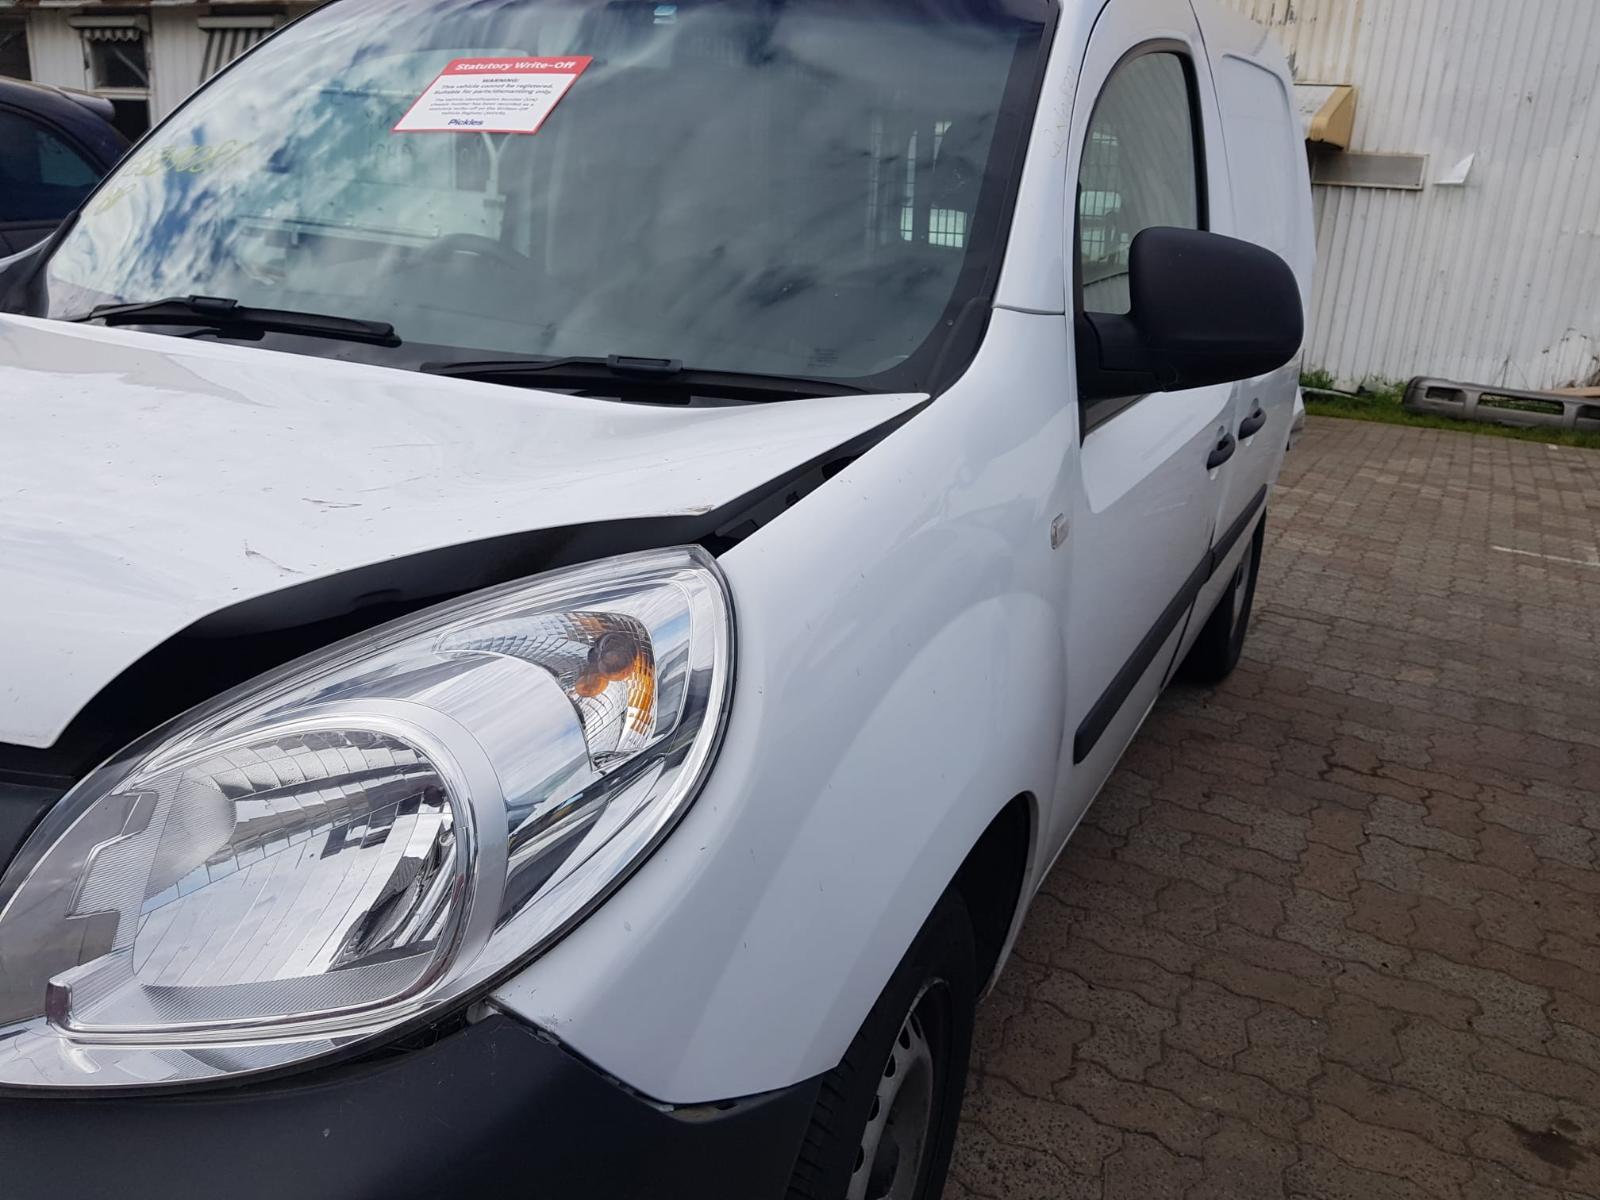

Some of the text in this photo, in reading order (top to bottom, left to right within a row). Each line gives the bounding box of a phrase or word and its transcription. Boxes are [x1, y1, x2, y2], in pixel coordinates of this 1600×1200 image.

[455, 61, 577, 71] Statutory Write-Off
[447, 118, 484, 126] Pickles
